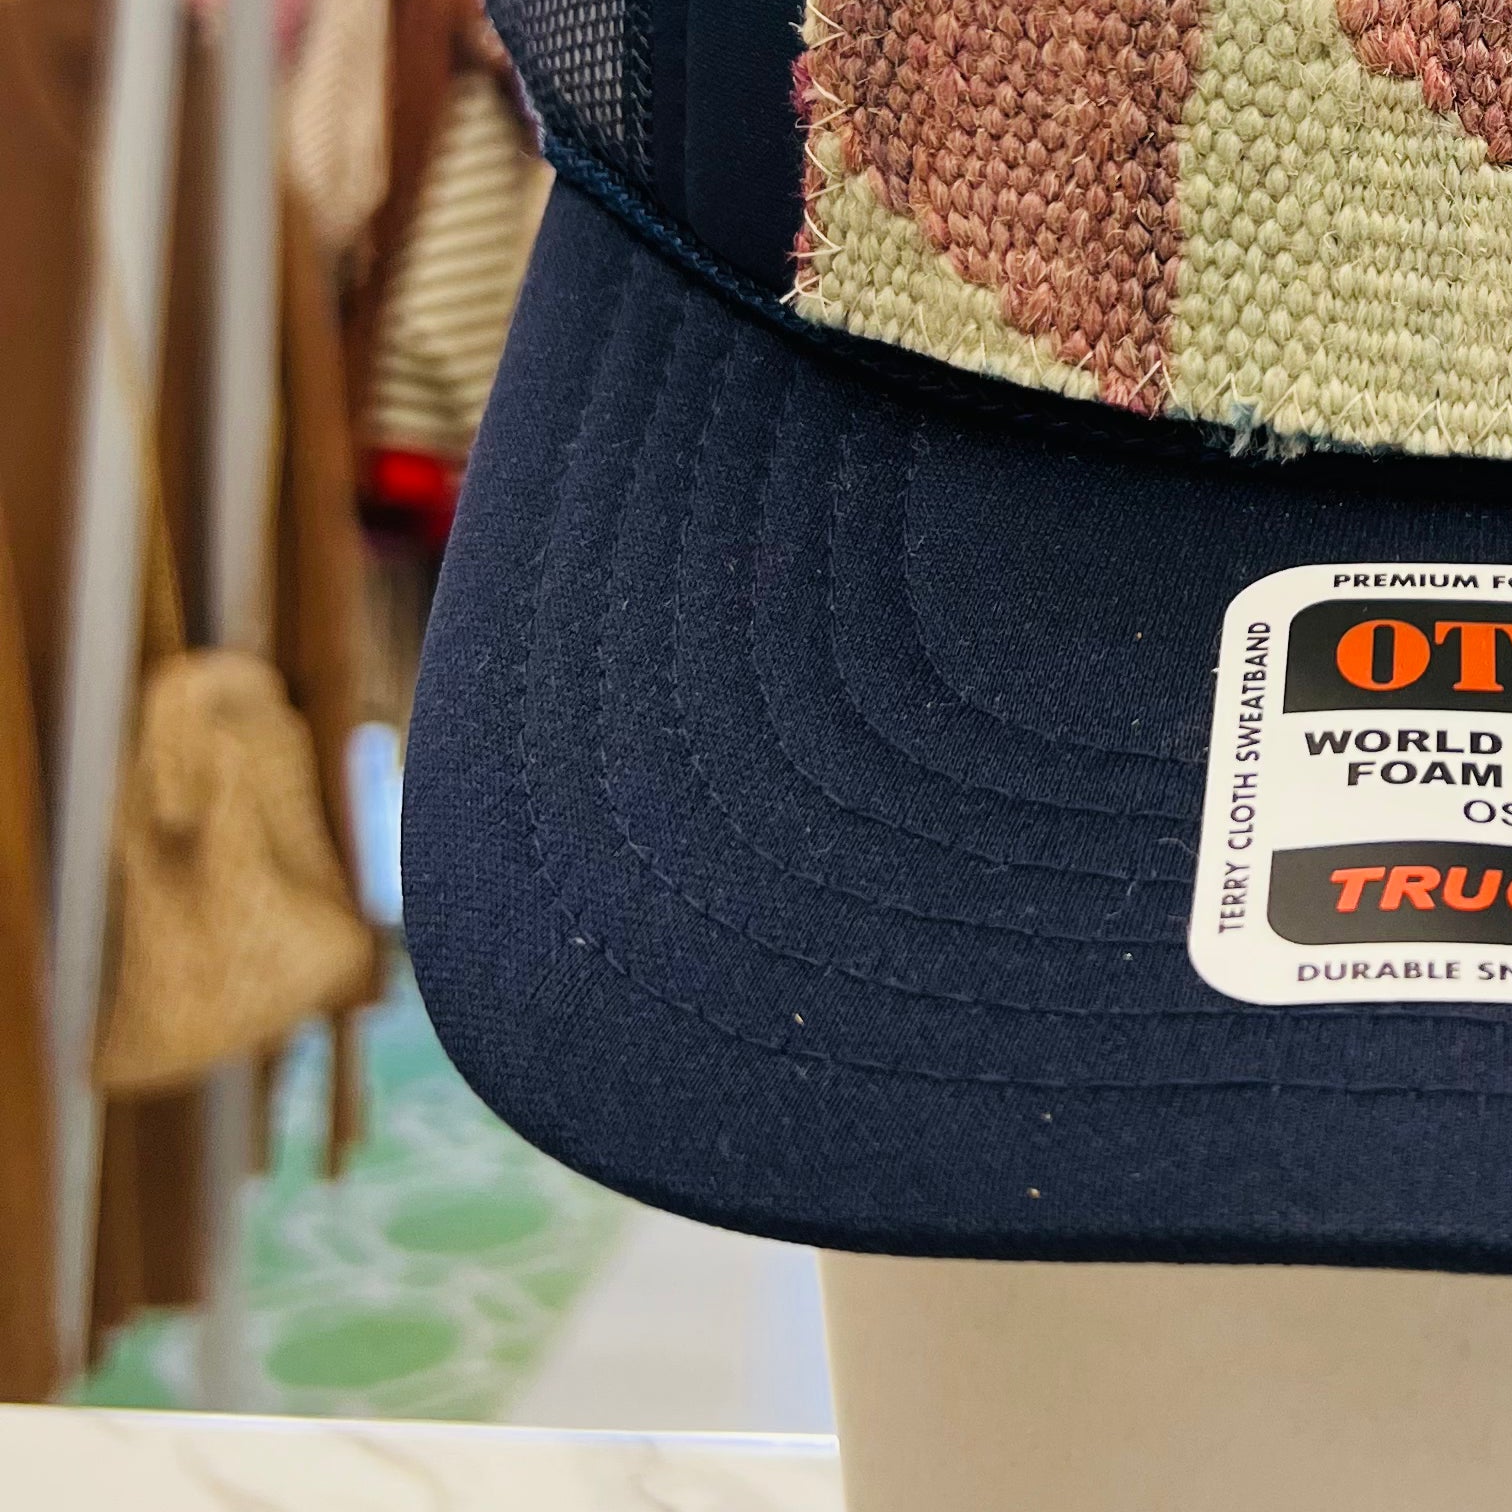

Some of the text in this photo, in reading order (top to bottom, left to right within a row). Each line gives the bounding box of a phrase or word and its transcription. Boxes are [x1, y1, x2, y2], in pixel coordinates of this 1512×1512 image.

[1333, 573, 1480, 589] PREMIUM
[1305, 730, 1502, 755] WORLD
[1218, 623, 1270, 934] TERRY CLOTH SWEATBAND
[1348, 761, 1502, 788] FOAM
[1297, 962, 1461, 982] DURABLE
